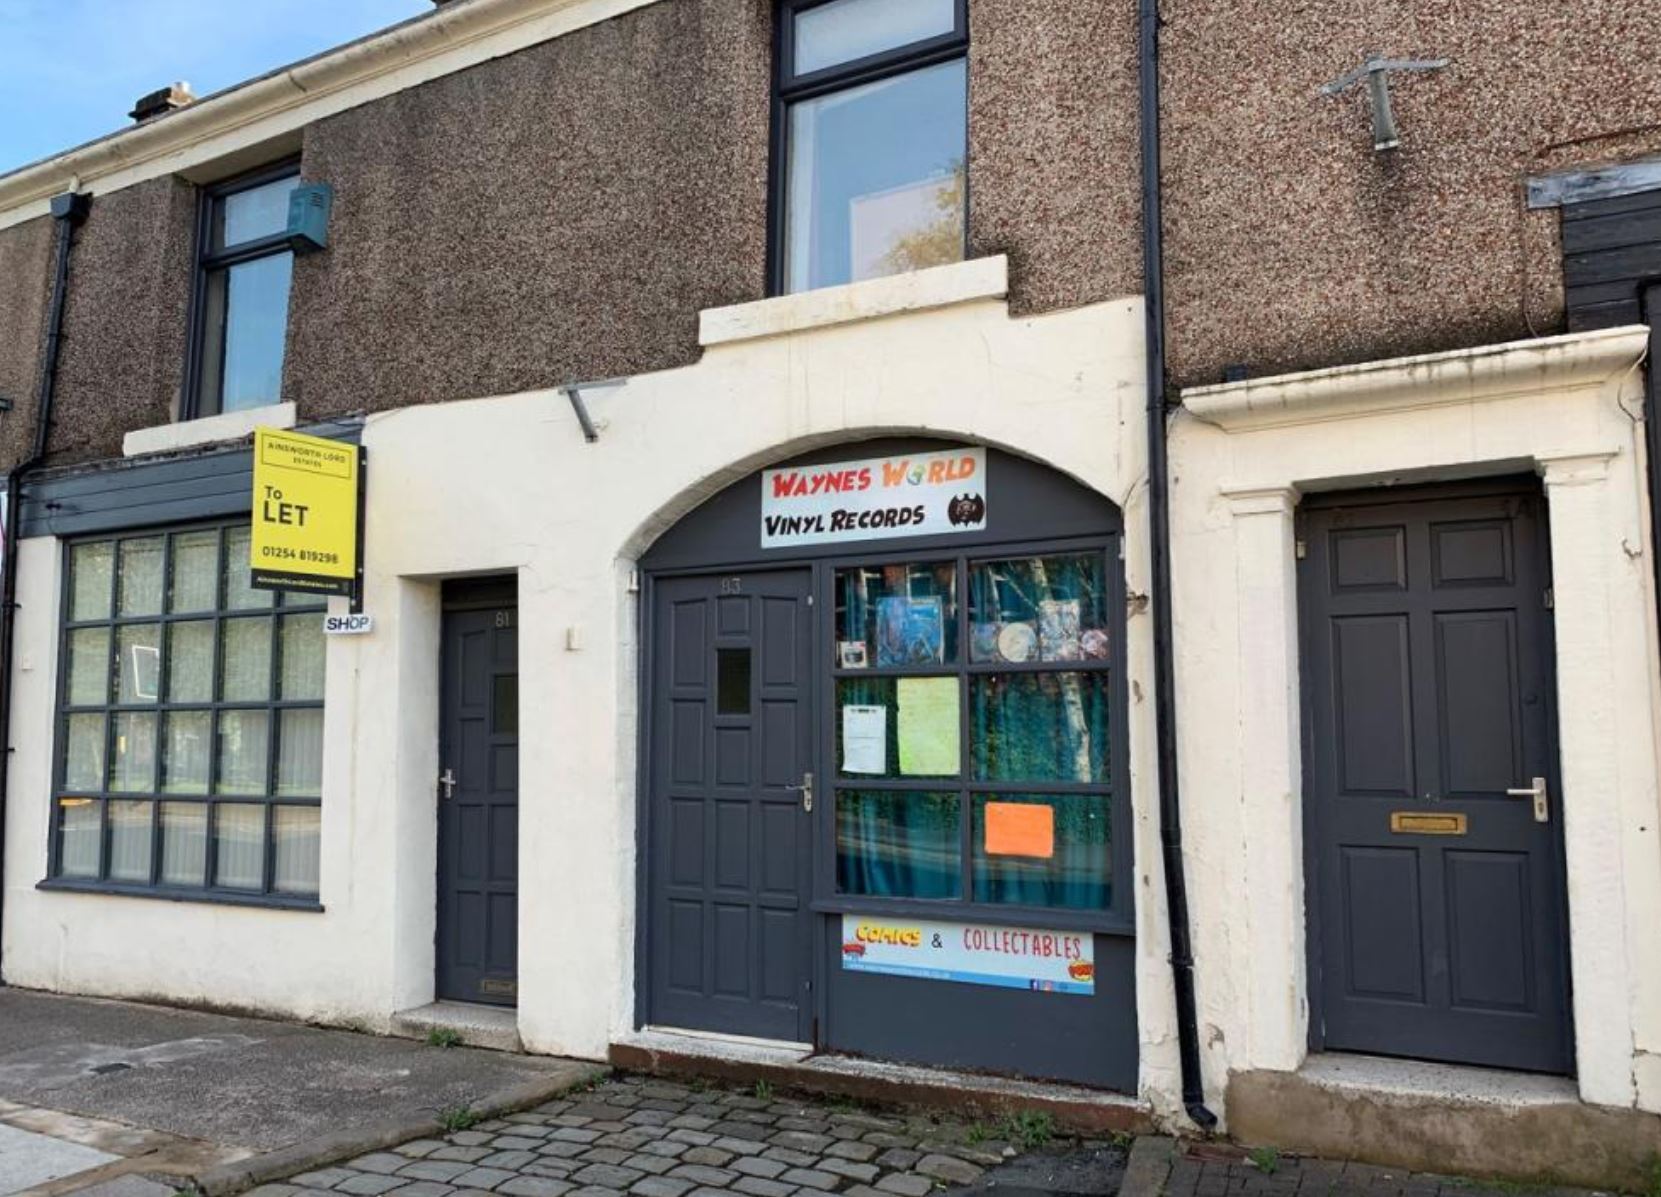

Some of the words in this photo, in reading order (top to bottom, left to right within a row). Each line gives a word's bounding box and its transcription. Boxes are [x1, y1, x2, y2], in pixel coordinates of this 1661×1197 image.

[772, 467, 871, 498] WAYNES
[263, 500, 308, 526] LET
[764, 514, 825, 537] VINYL
[830, 505, 925, 532] RECORDS
[262, 546, 295, 558] 01254
[327, 615, 369, 630] SHOP
[495, 611, 509, 627] 81
[855, 921, 922, 947] COMICS
[931, 933, 943, 949] &
[963, 927, 1081, 960] COLLECTABLES
